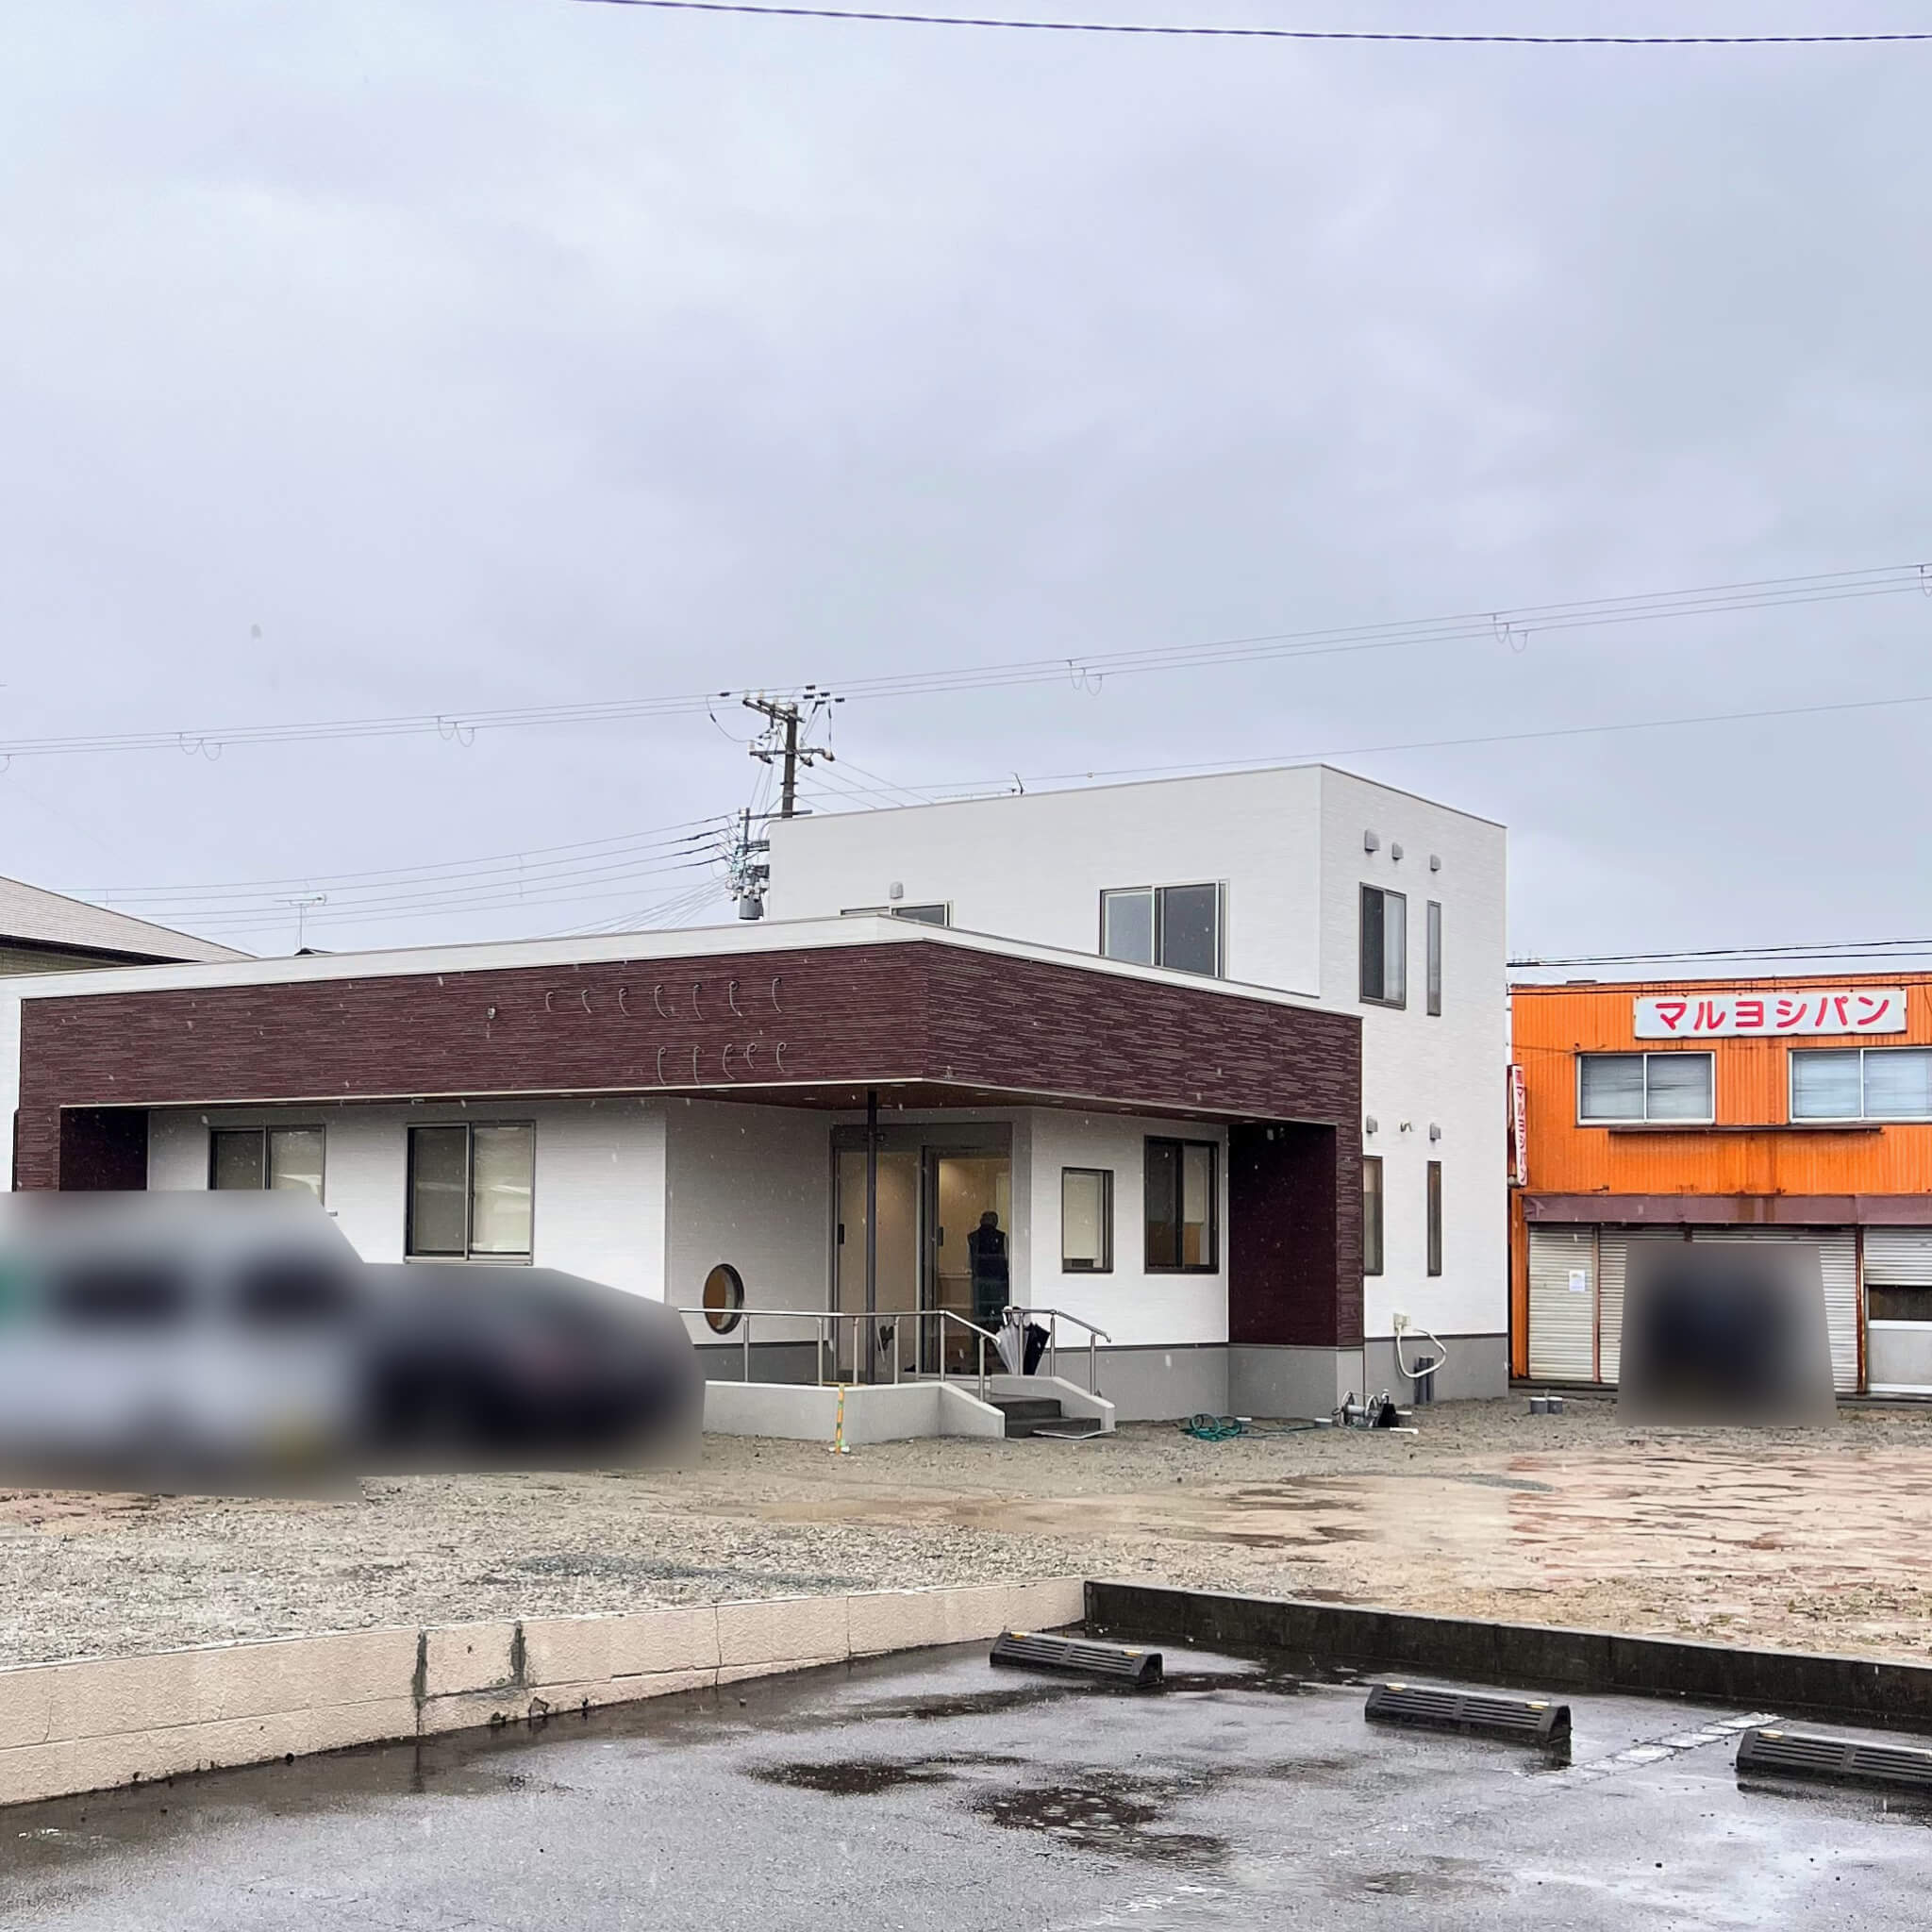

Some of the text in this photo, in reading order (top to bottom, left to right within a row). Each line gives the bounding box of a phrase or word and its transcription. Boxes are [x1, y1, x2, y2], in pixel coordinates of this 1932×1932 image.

[1655, 995, 1890, 1031] マルヨシパン
